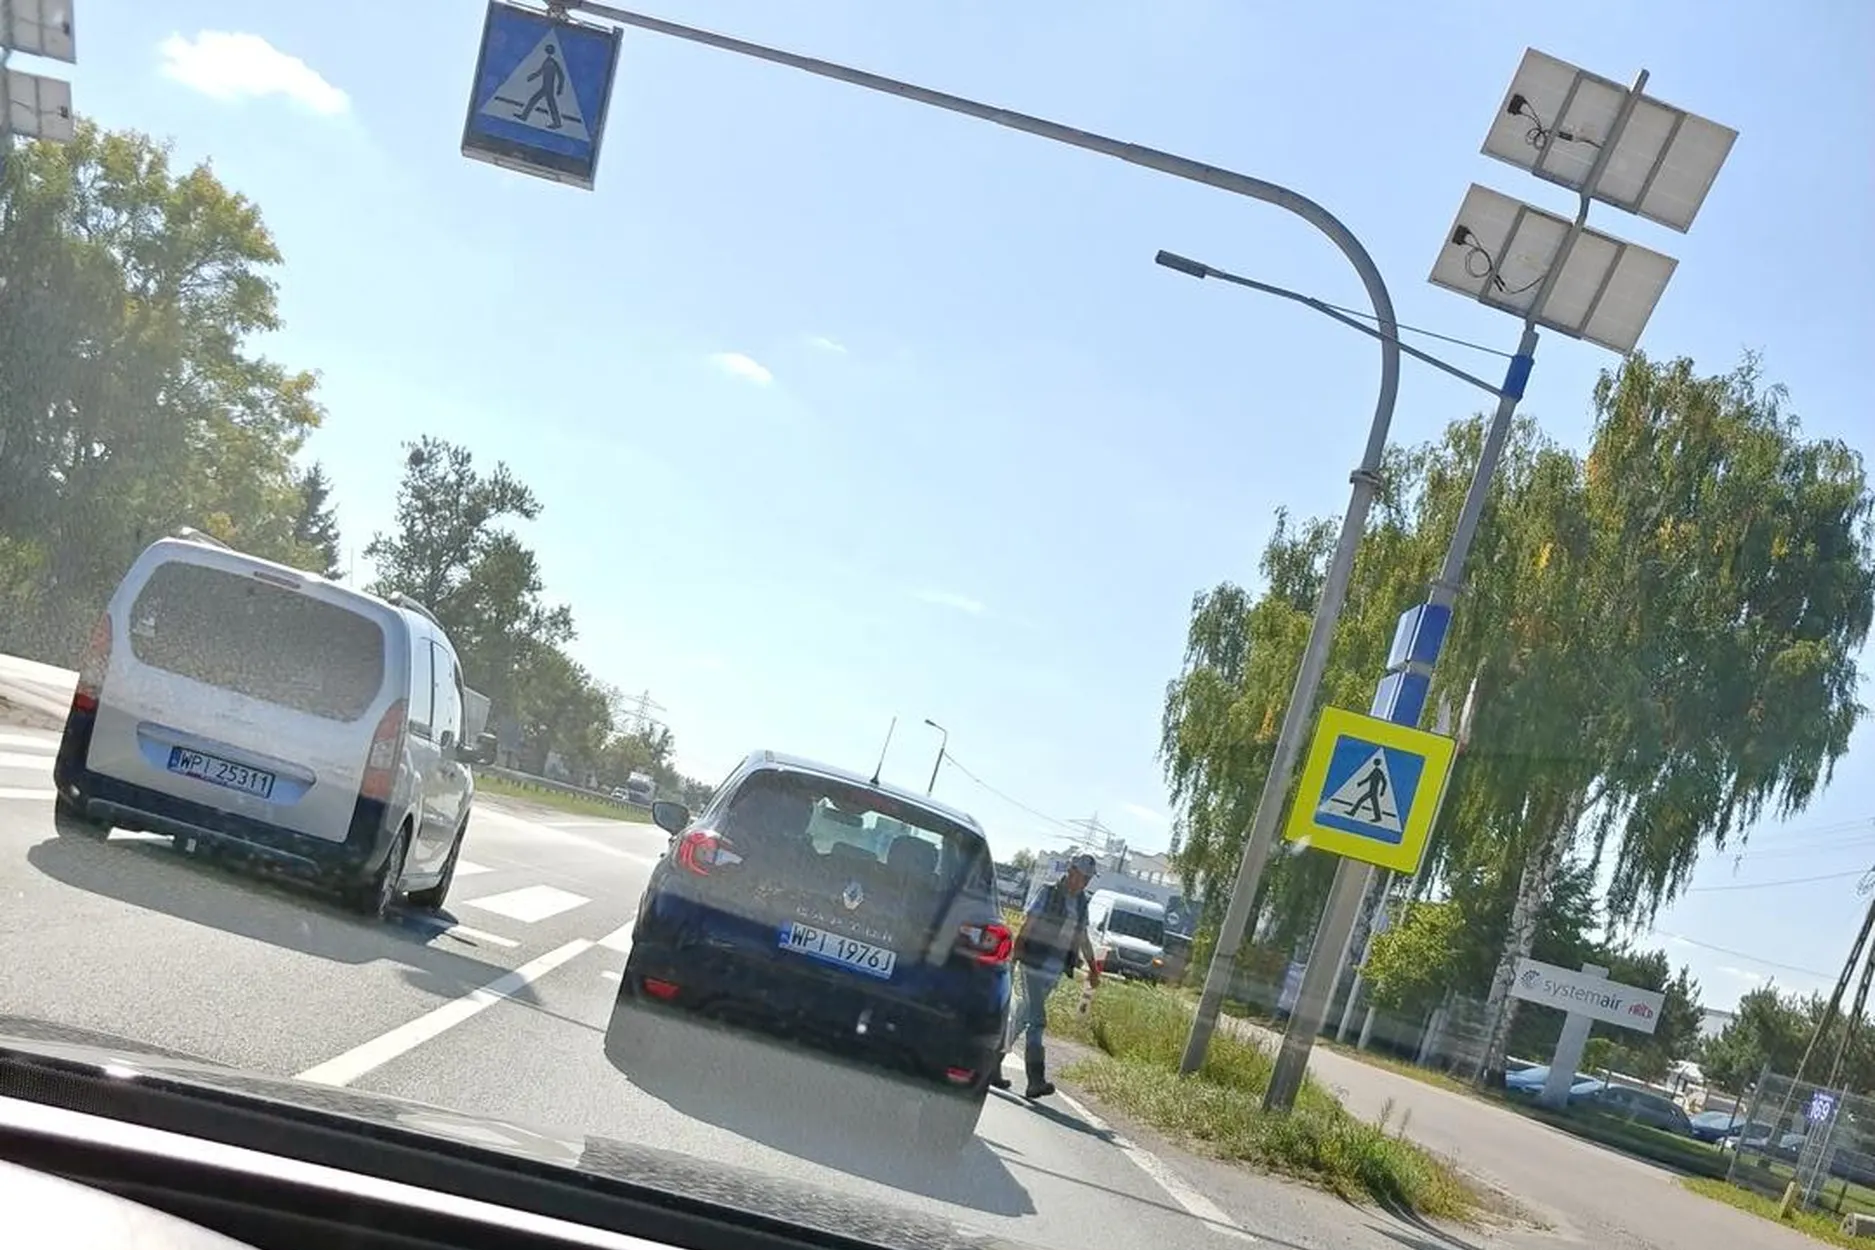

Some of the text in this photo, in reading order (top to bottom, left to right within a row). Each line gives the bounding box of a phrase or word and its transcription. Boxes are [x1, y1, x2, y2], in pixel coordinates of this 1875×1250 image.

[180, 750, 211, 773] WPI
[216, 763, 268, 791] 25311
[791, 922, 827, 952] WPI
[837, 939, 892, 971] 1976J
[1543, 980, 1623, 1010] systemair
